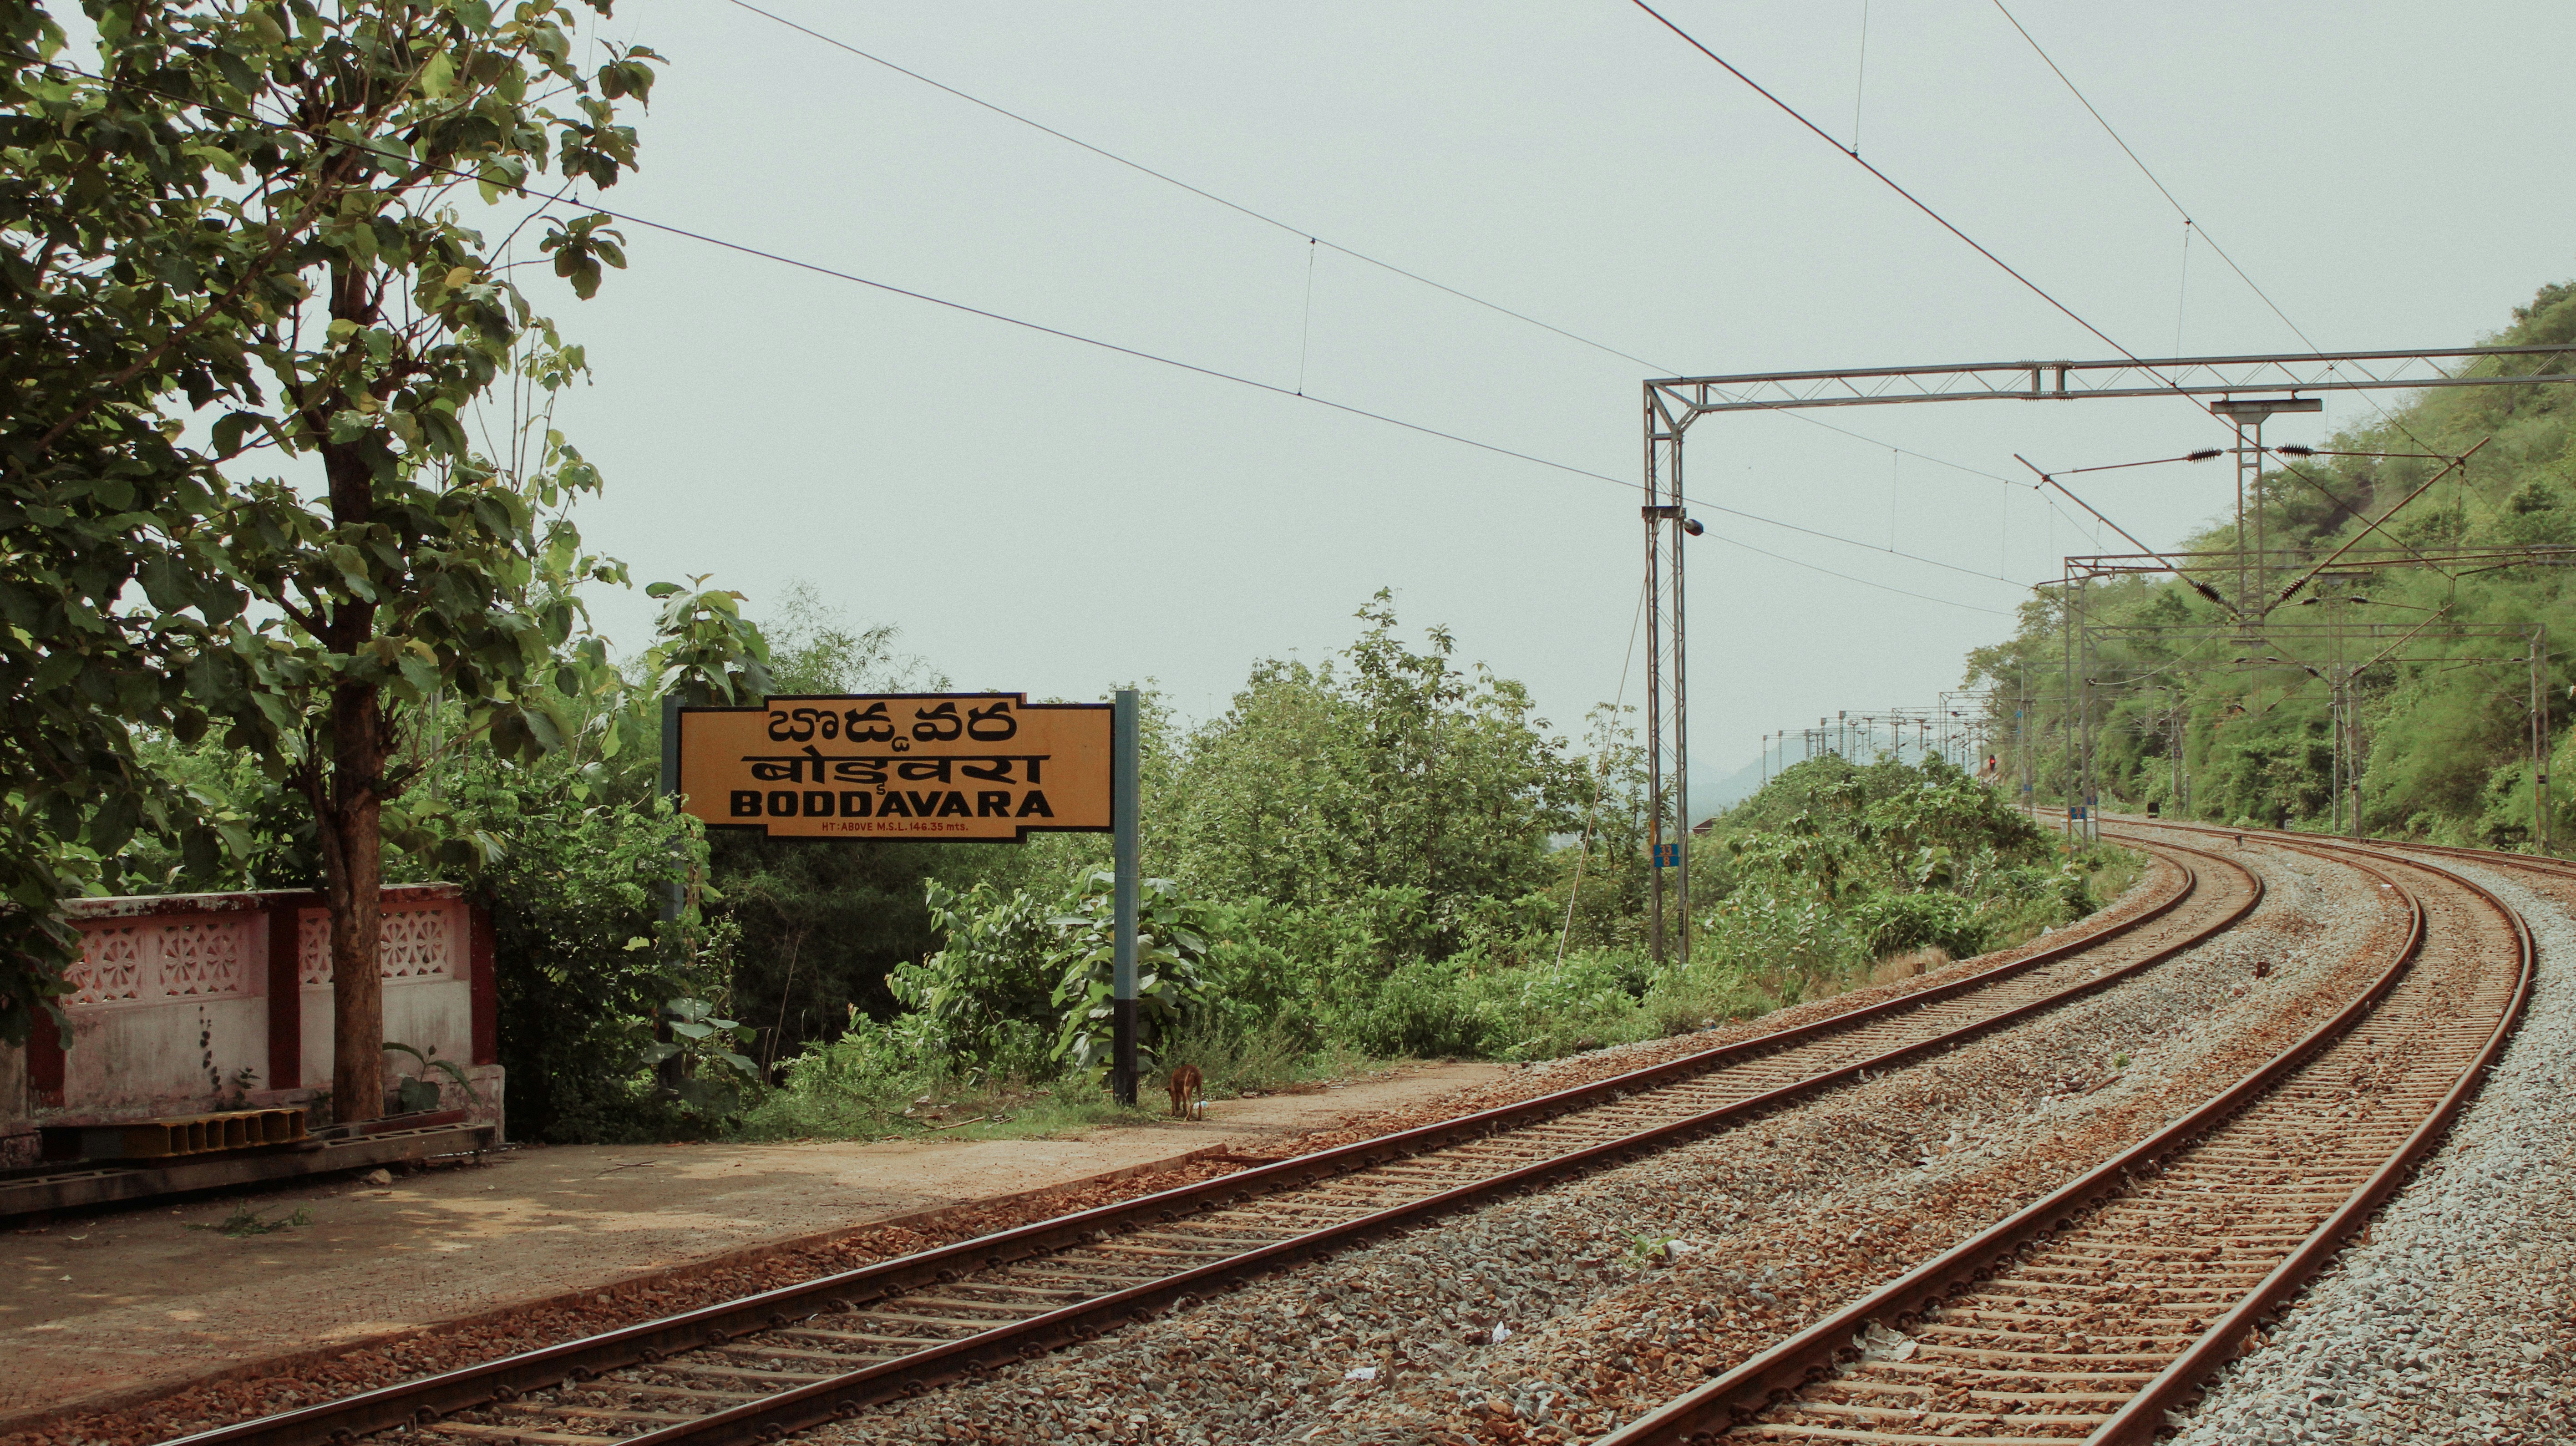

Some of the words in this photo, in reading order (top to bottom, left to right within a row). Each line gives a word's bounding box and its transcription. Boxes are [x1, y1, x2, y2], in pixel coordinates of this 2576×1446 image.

[768, 702, 1017, 752] బొడ్డవర
[740, 745, 1051, 795] बोड्डवरा
[730, 790, 1055, 817] BODDAVARA
[877, 822, 908, 831] M.S.L.
[910, 822, 943, 831] 146.35
[946, 822, 969, 831] mts.
[1659, 845, 1672, 855] 33
[1663, 856, 1670, 866] 8
